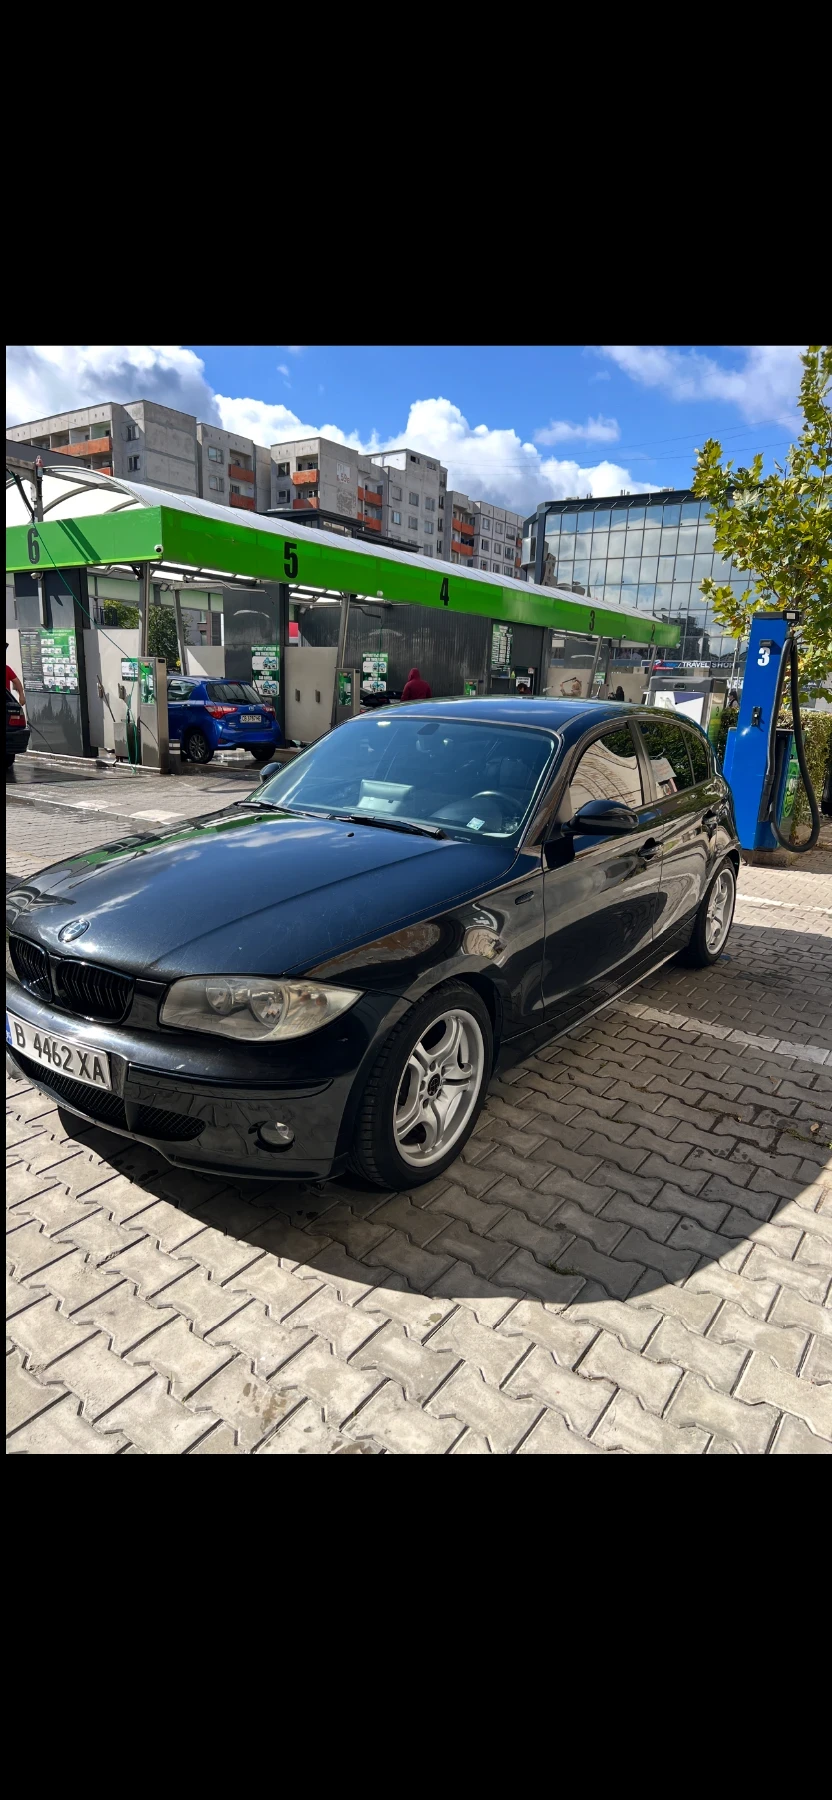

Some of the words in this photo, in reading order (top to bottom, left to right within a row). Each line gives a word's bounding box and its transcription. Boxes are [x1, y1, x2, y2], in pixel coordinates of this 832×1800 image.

[27, 527, 40, 564] 6
[284, 541, 298, 578] 5
[440, 577, 449, 606] 4
[589, 610, 596, 631] 3
[650, 624, 656, 642] 2
[757, 646, 770, 666] 3
[14, 1021, 26, 1048] B
[33, 1033, 75, 1073] 4462
[76, 1049, 106, 1083] XA
